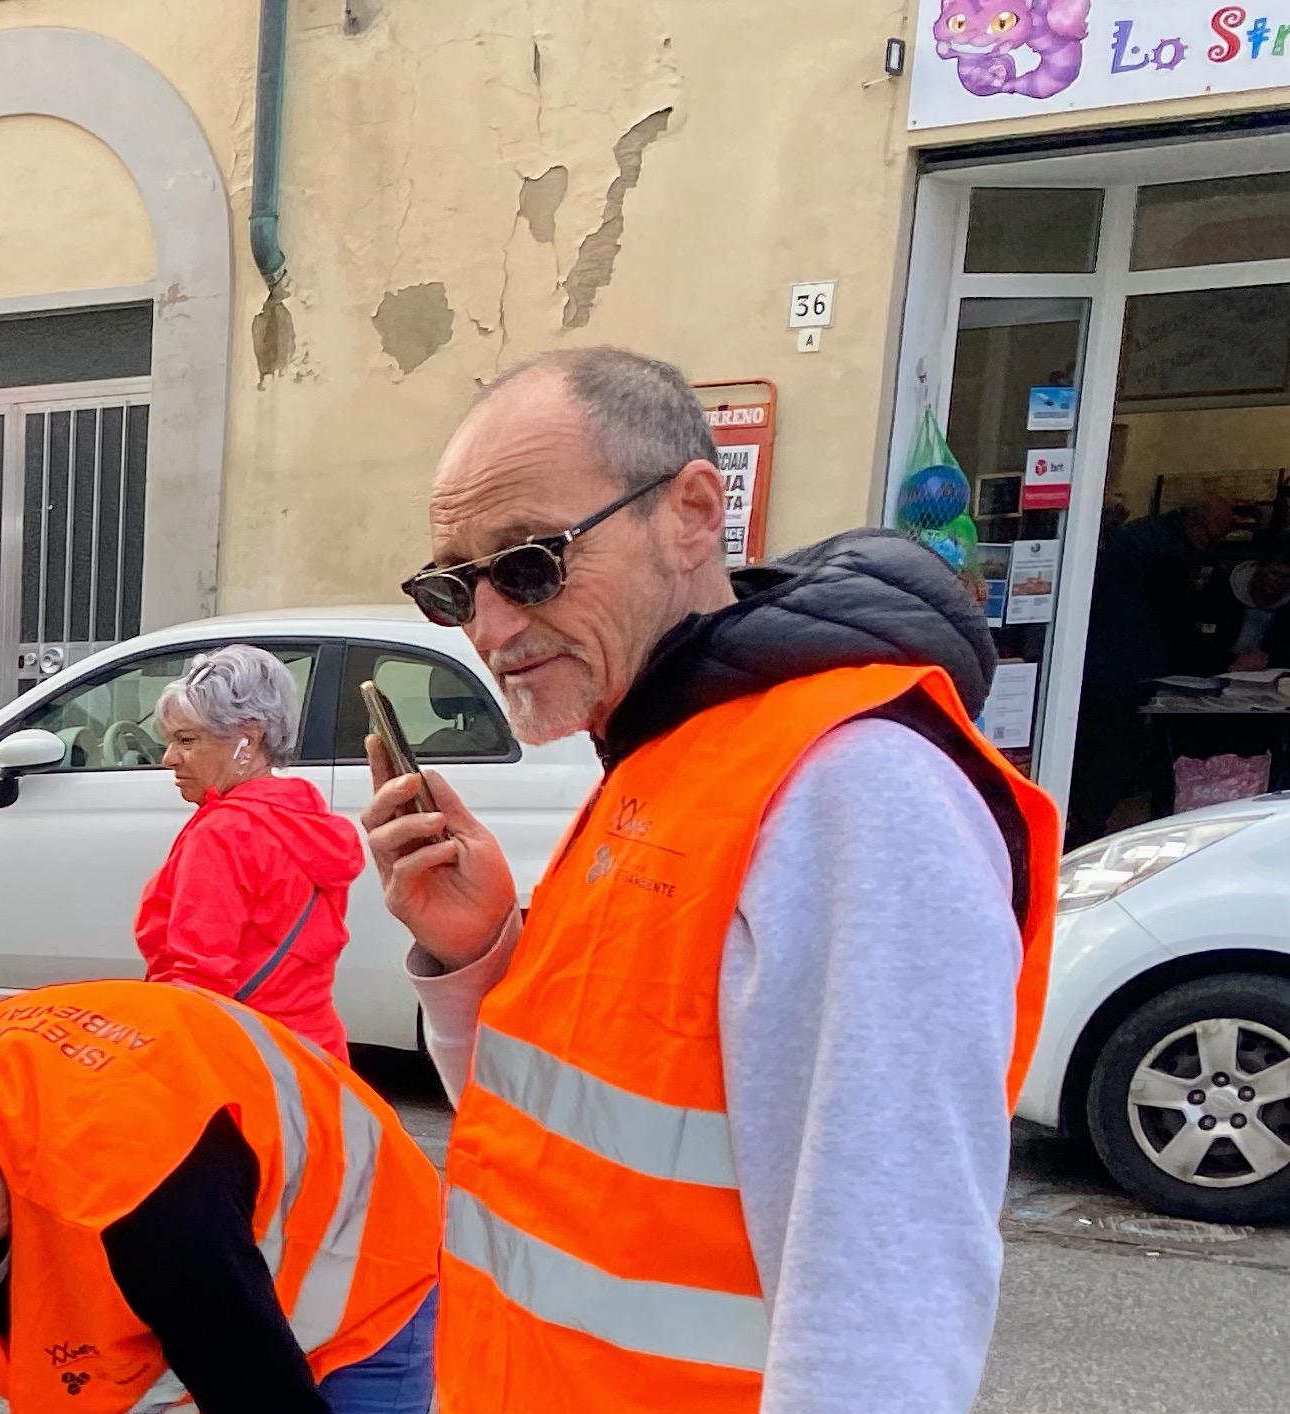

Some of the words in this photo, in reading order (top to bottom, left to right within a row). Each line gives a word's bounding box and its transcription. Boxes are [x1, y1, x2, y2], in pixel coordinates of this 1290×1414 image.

[1111, 19, 1188, 74] Lo
[795, 293, 826, 317] 36
[805, 333, 814, 347] A
